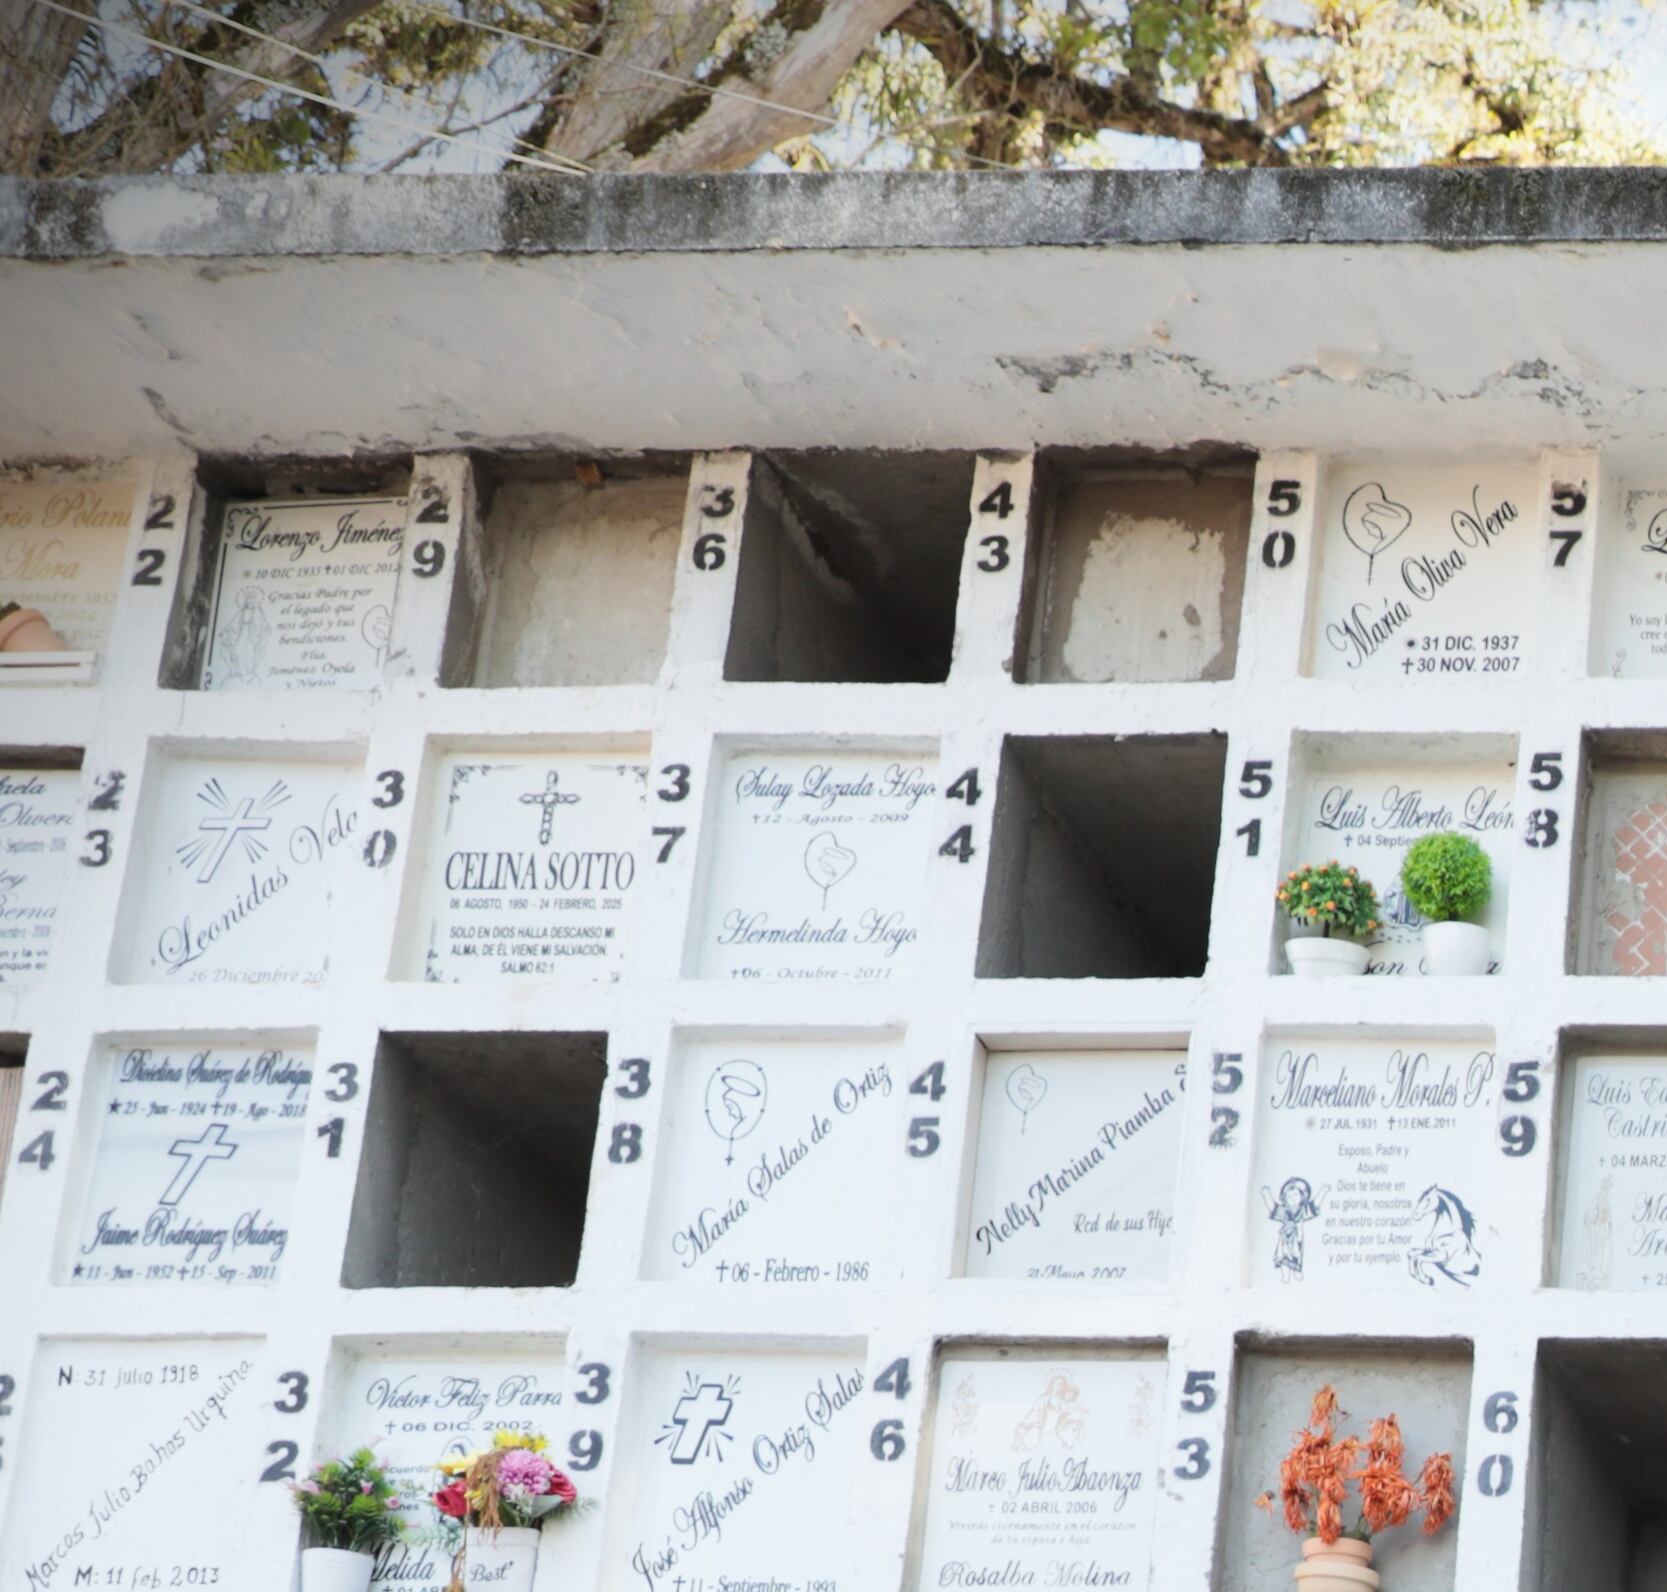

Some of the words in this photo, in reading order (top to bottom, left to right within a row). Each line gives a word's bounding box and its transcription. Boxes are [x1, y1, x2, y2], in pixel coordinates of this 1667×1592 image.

[235, 514, 321, 561] Lorenzo
[1327, 600, 1412, 669] María
[1401, 549, 1468, 601] Oliva
[1452, 484, 1519, 549] Vera
[1417, 657, 1437, 673] 30
[1482, 657, 1521, 672] 2007
[1421, 636, 1440, 652] 31
[1482, 635, 1520, 651] 1937
[799, 764, 875, 811] Lozada
[1314, 786, 1367, 831] Luis
[1372, 786, 1452, 829] Alberto
[445, 852, 538, 890] CELINA
[544, 853, 636, 890] SOTTO
[157, 867, 289, 975] Leonidas
[718, 908, 848, 945] Hermelinda
[1271, 1050, 1376, 1110] Marceliano
[1381, 1050, 1460, 1109] Morales
[673, 1200, 748, 1269] María
[748, 1140, 809, 1201] Salas
[811, 1115, 832, 1145] de
[834, 1064, 892, 1115] Ortiz
[976, 1203, 1039, 1256] Nelly
[1029, 1148, 1104, 1212] Marina
[1100, 1090, 1176, 1150] Piamba
[83, 1208, 140, 1254] Jaime
[732, 1263, 751, 1283] 06
[764, 1258, 820, 1283] Febrero
[836, 1262, 870, 1283] 1986
[161, 1365, 199, 1384] 1918
[496, 1375, 562, 1407] Parra
[402, 1422, 426, 1431] 06
[483, 1421, 533, 1430] 2002
[675, 1479, 752, 1550] Alfonso
[754, 1425, 815, 1475] Ortiz
[806, 1369, 864, 1431] Salas
[25, 1525, 84, 1592] Marcos
[89, 1488, 130, 1539] Julio
[170, 1567, 219, 1585] 2013
